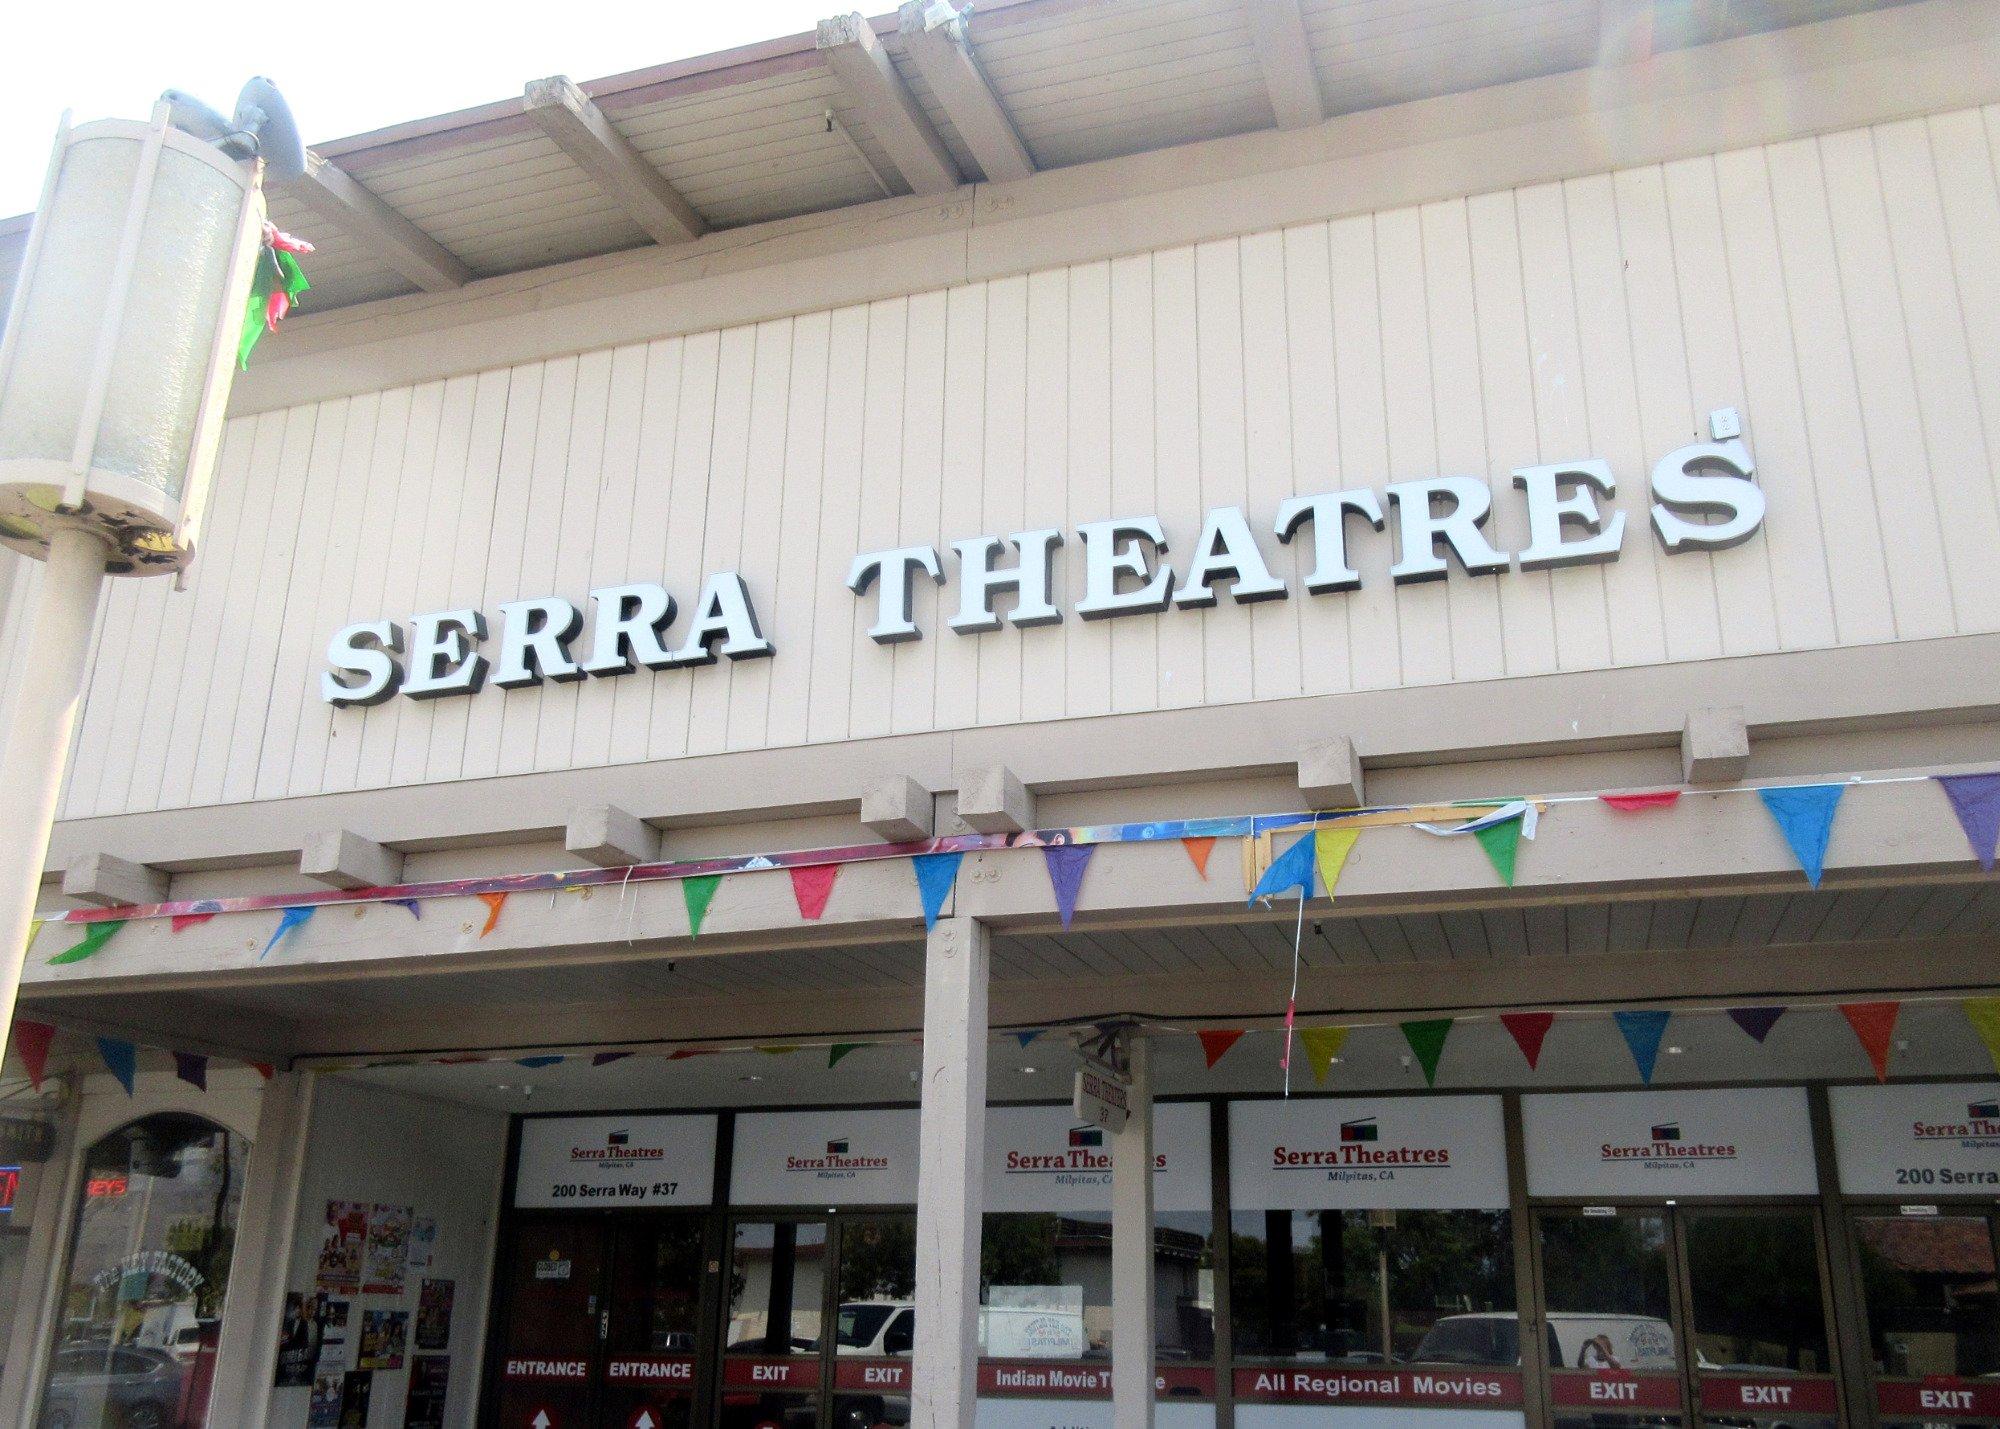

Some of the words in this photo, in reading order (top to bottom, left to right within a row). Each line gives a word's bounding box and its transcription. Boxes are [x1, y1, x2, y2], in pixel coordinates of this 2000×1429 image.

[321, 571, 776, 707] SERRA
[847, 437, 1767, 643] THEATRES
[1913, 1121, 1969, 1136] Serra
[571, 1147, 606, 1159] Serra
[607, 1146, 664, 1158] Theatres
[1273, 1146, 1338, 1165] Serra
[1339, 1144, 1449, 1164] Theatres
[1601, 1143, 1650, 1157] Serra
[1652, 1142, 1736, 1156] Theatres
[787, 1156, 824, 1168] Serra
[826, 1155, 888, 1168] Theatres
[1007, 1151, 1064, 1168] Serra
[1067, 1149, 1167, 1168] Thes
[1055, 1174, 1100, 1186] Milpitas,
[1328, 1171, 1377, 1183] Milpitas,
[1379, 1171, 1395, 1180] CA
[1895, 1168, 1935, 1184] 200
[1940, 1168, 1999, 1184] Serra
[552, 1184, 577, 1197] 200
[580, 1184, 616, 1197] Serra
[619, 1183, 647, 1199] Way
[652, 1182, 678, 1196] #37
[506, 1360, 586, 1377] ENTRANCE
[609, 1361, 692, 1378] ENTRANCE
[752, 1365, 790, 1381] EXIT
[864, 1367, 903, 1383] EXIT
[996, 1369, 1046, 1387] Indian
[1049, 1370, 1098, 1388] Movie
[1254, 1373, 1286, 1392] All
[1293, 1373, 1401, 1397] Regional
[1412, 1376, 1503, 1397] Movies
[1589, 1381, 1639, 1400] EXIT
[1740, 1385, 1792, 1404] EXIT
[1920, 1389, 1974, 1409] EXIT
